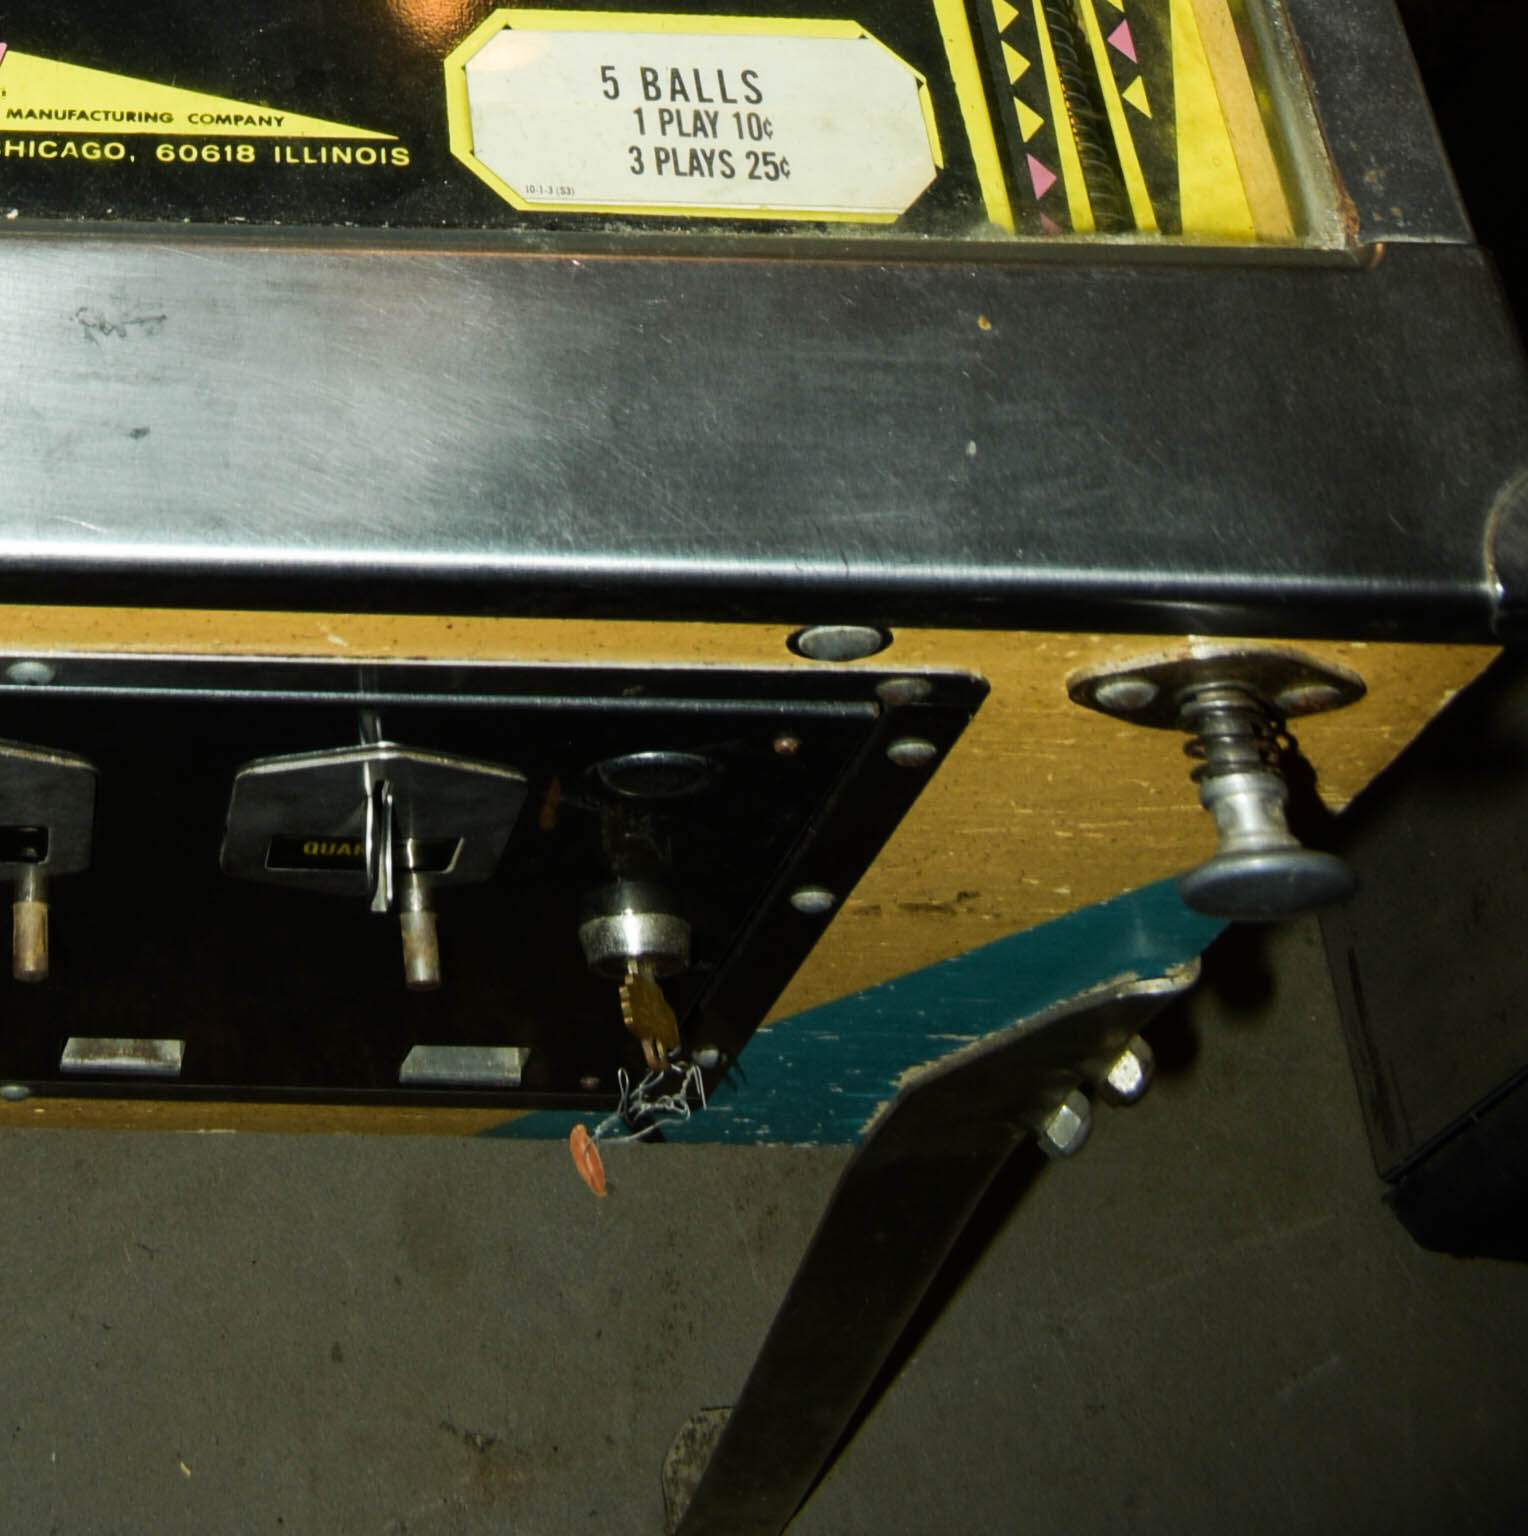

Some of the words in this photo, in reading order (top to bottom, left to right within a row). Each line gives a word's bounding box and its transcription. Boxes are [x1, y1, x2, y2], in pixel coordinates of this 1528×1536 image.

[600, 65, 620, 100] 5
[639, 65, 764, 105] BALLS
[6, 108, 174, 124] MANUFACTURING
[187, 112, 285, 128] COMPANY
[633, 106, 646, 136] 1
[658, 108, 719, 139] PLAY
[732, 110, 774, 142] 10¢
[155, 144, 256, 164] 60618
[274, 145, 411, 167] ILLINOIS
[628, 145, 645, 175] 3
[654, 146, 736, 179] PLAYS
[745, 150, 791, 182] 25¢
